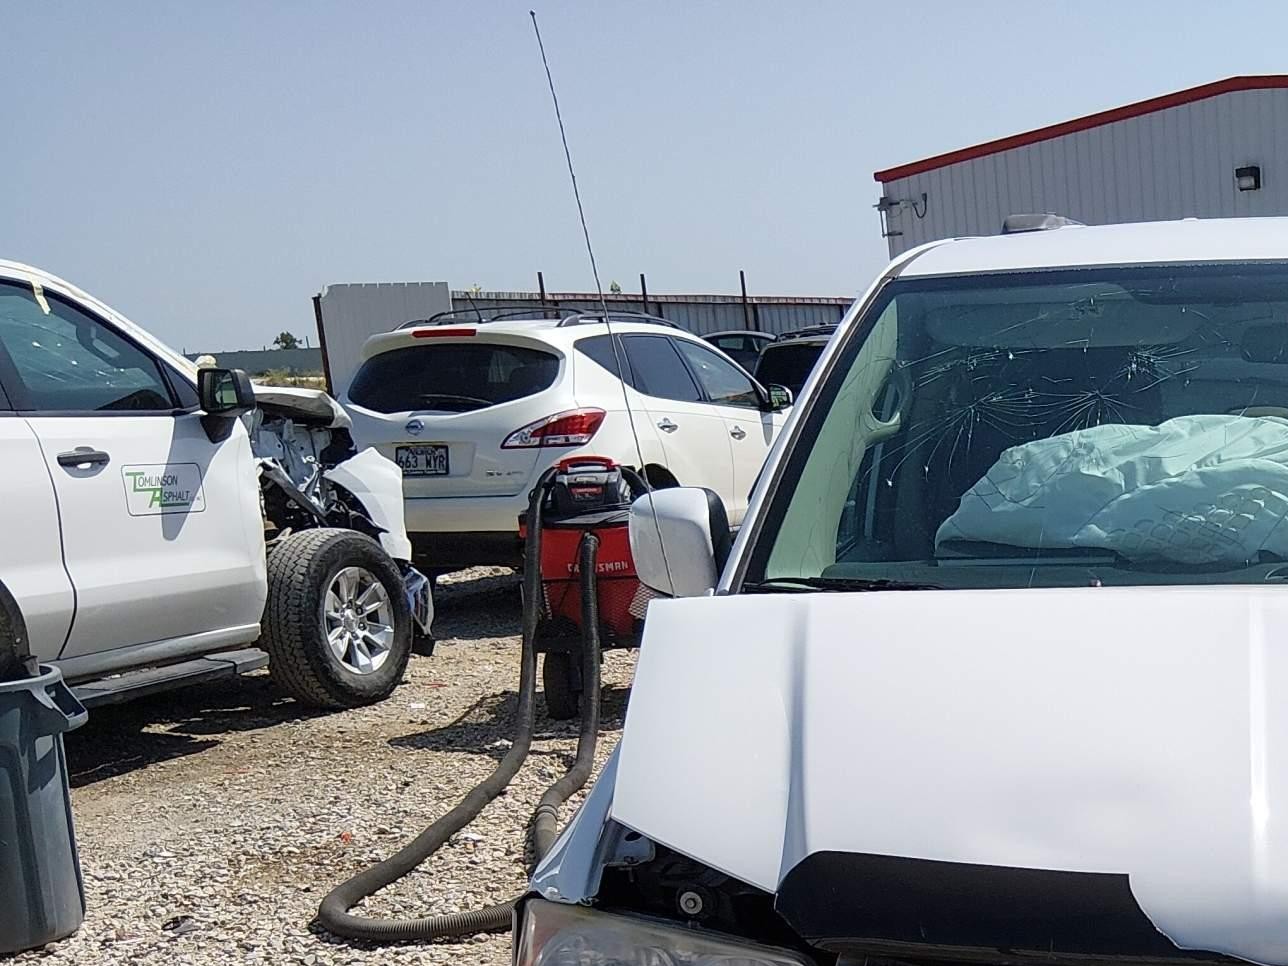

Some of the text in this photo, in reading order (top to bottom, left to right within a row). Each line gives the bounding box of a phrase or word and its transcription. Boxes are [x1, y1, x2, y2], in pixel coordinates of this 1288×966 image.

[125, 471, 178, 492] TOMLINSON
[148, 488, 190, 508] ASPHALT
[567, 560, 628, 573] CRSMAN
